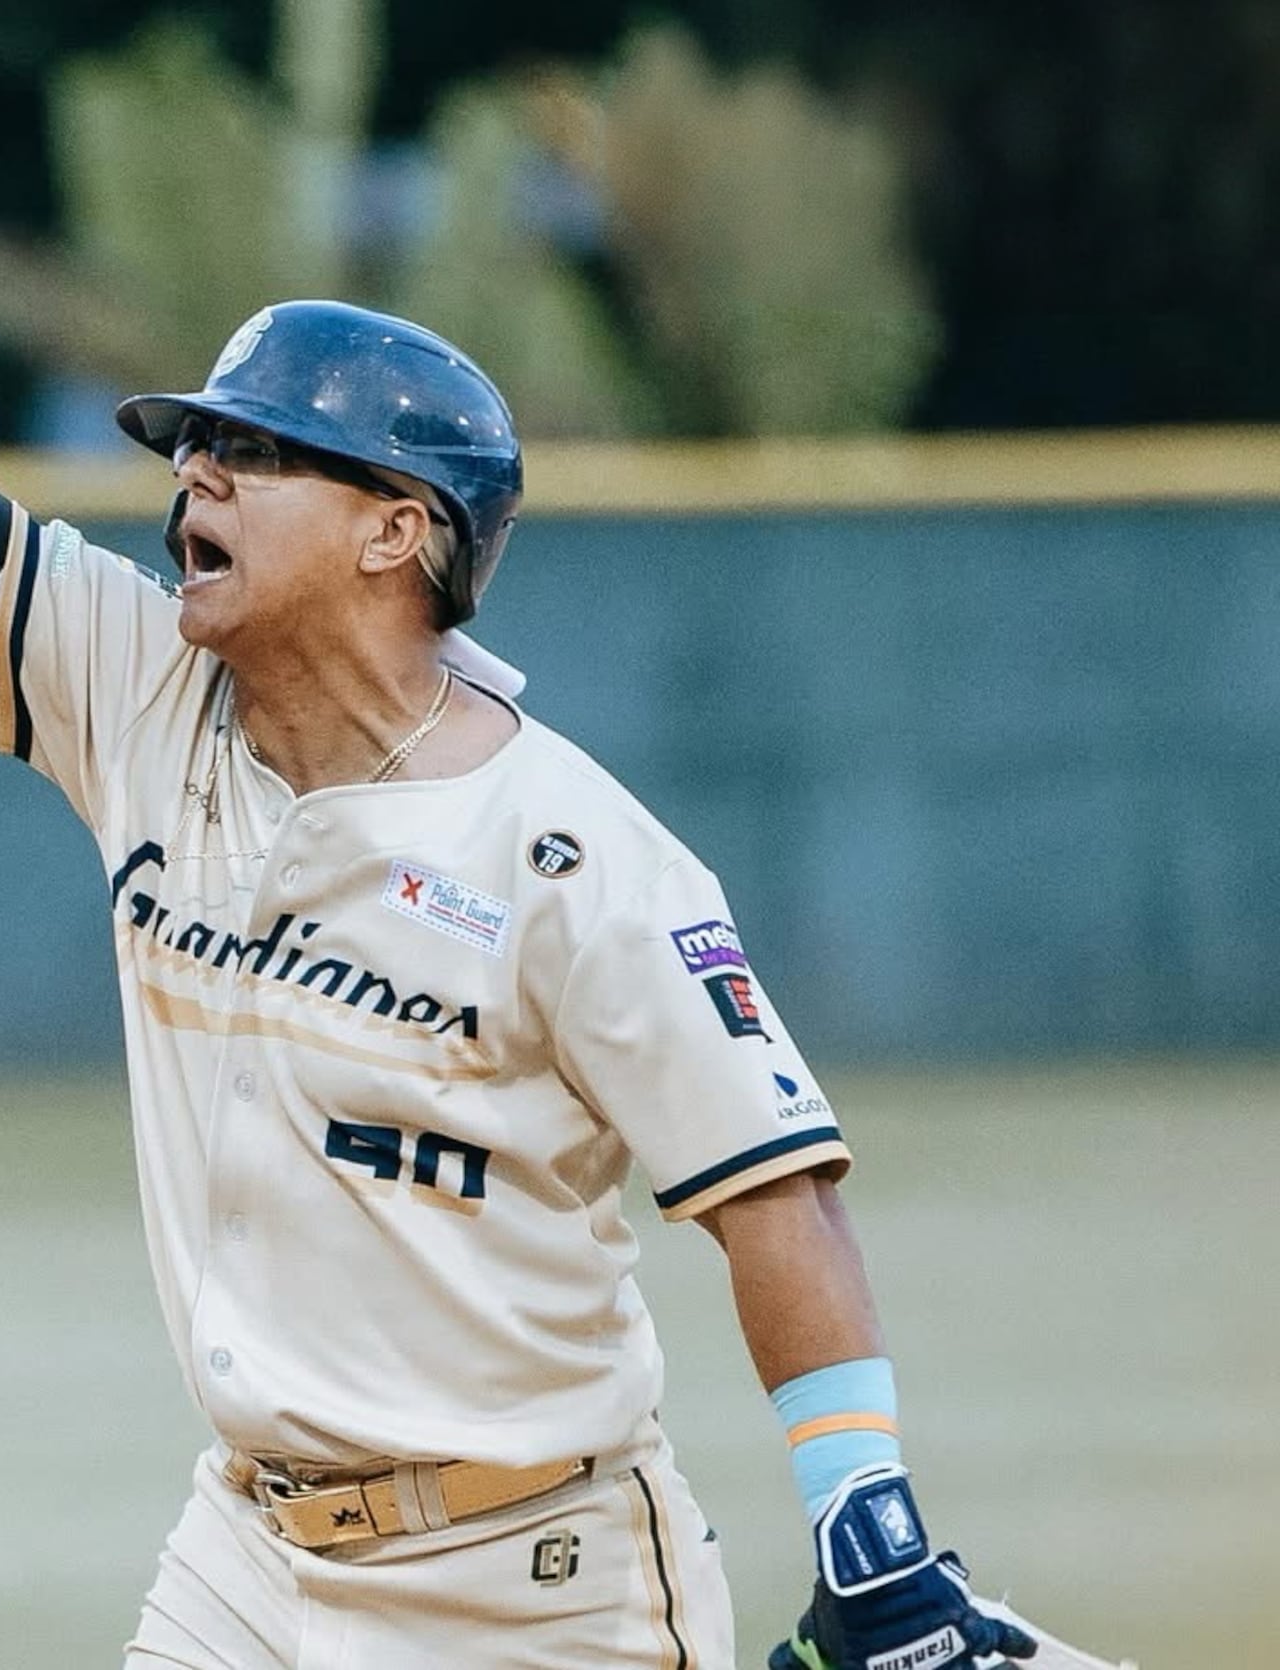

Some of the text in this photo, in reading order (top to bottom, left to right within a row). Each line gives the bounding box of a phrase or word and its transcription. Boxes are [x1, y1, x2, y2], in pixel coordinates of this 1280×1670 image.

[539, 849, 565, 873] 19
[430, 883, 465, 913] Point
[466, 898, 505, 930] Guard
